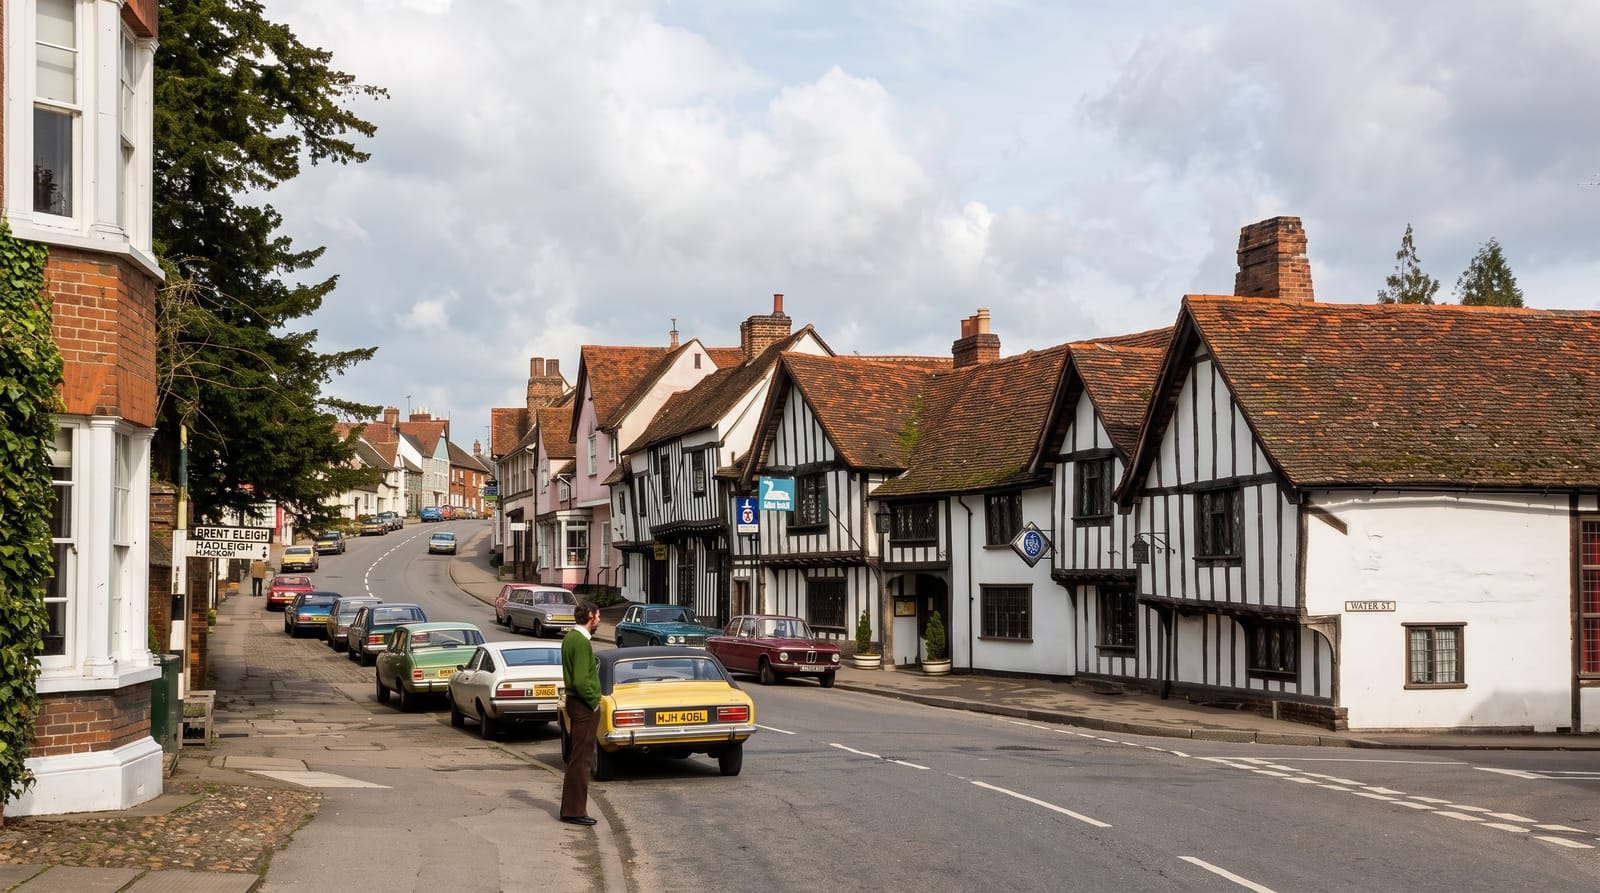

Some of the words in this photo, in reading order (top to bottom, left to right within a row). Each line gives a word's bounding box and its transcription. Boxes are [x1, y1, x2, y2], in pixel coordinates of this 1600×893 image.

[197, 528, 229, 538] BRENT
[233, 530, 268, 540] ELEIGH
[196, 541, 253, 551] HADLEIGH
[1351, 602, 1378, 610] WATER
[657, 713, 678, 723] MJH
[680, 711, 706, 722] 406L
